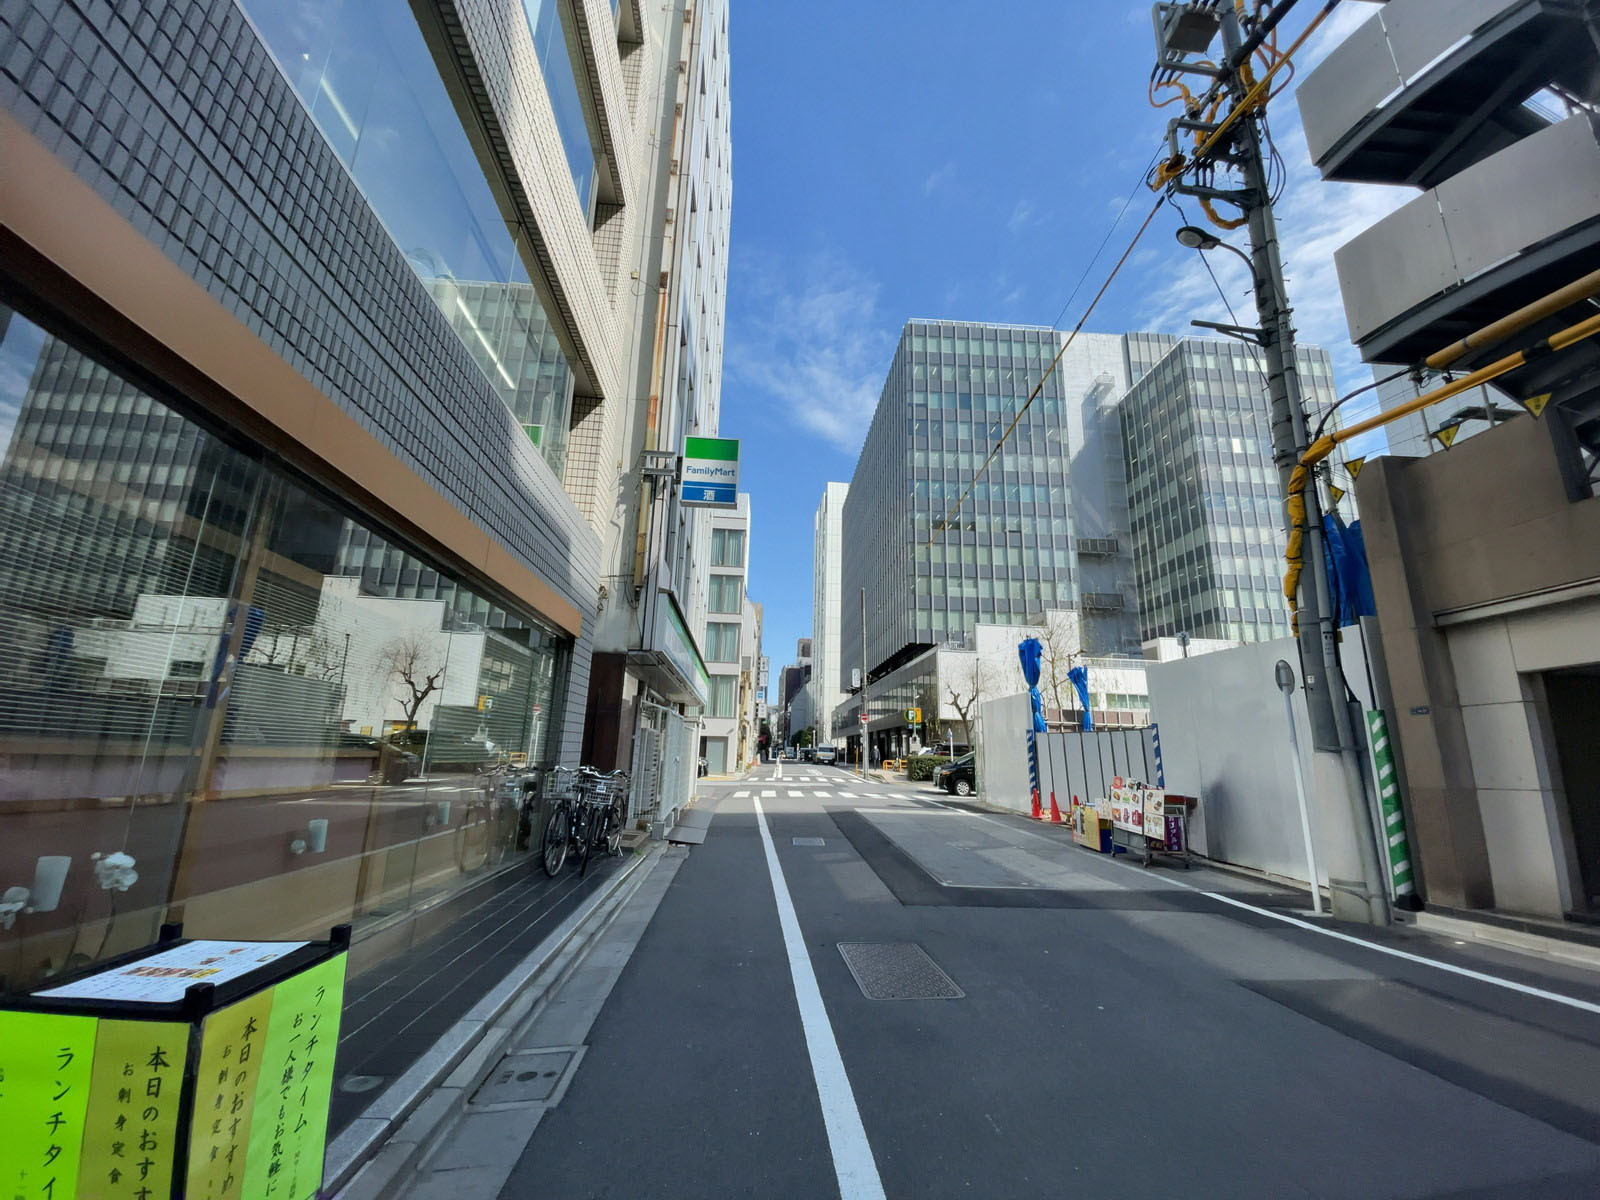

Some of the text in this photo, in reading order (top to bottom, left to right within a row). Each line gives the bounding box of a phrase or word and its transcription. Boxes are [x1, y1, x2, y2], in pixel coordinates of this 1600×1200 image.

[686, 465, 735, 477] FamilyMart
[221, 1016, 258, 1195] 本日のおすすめ
[294, 985, 325, 1134] ランチタイム
